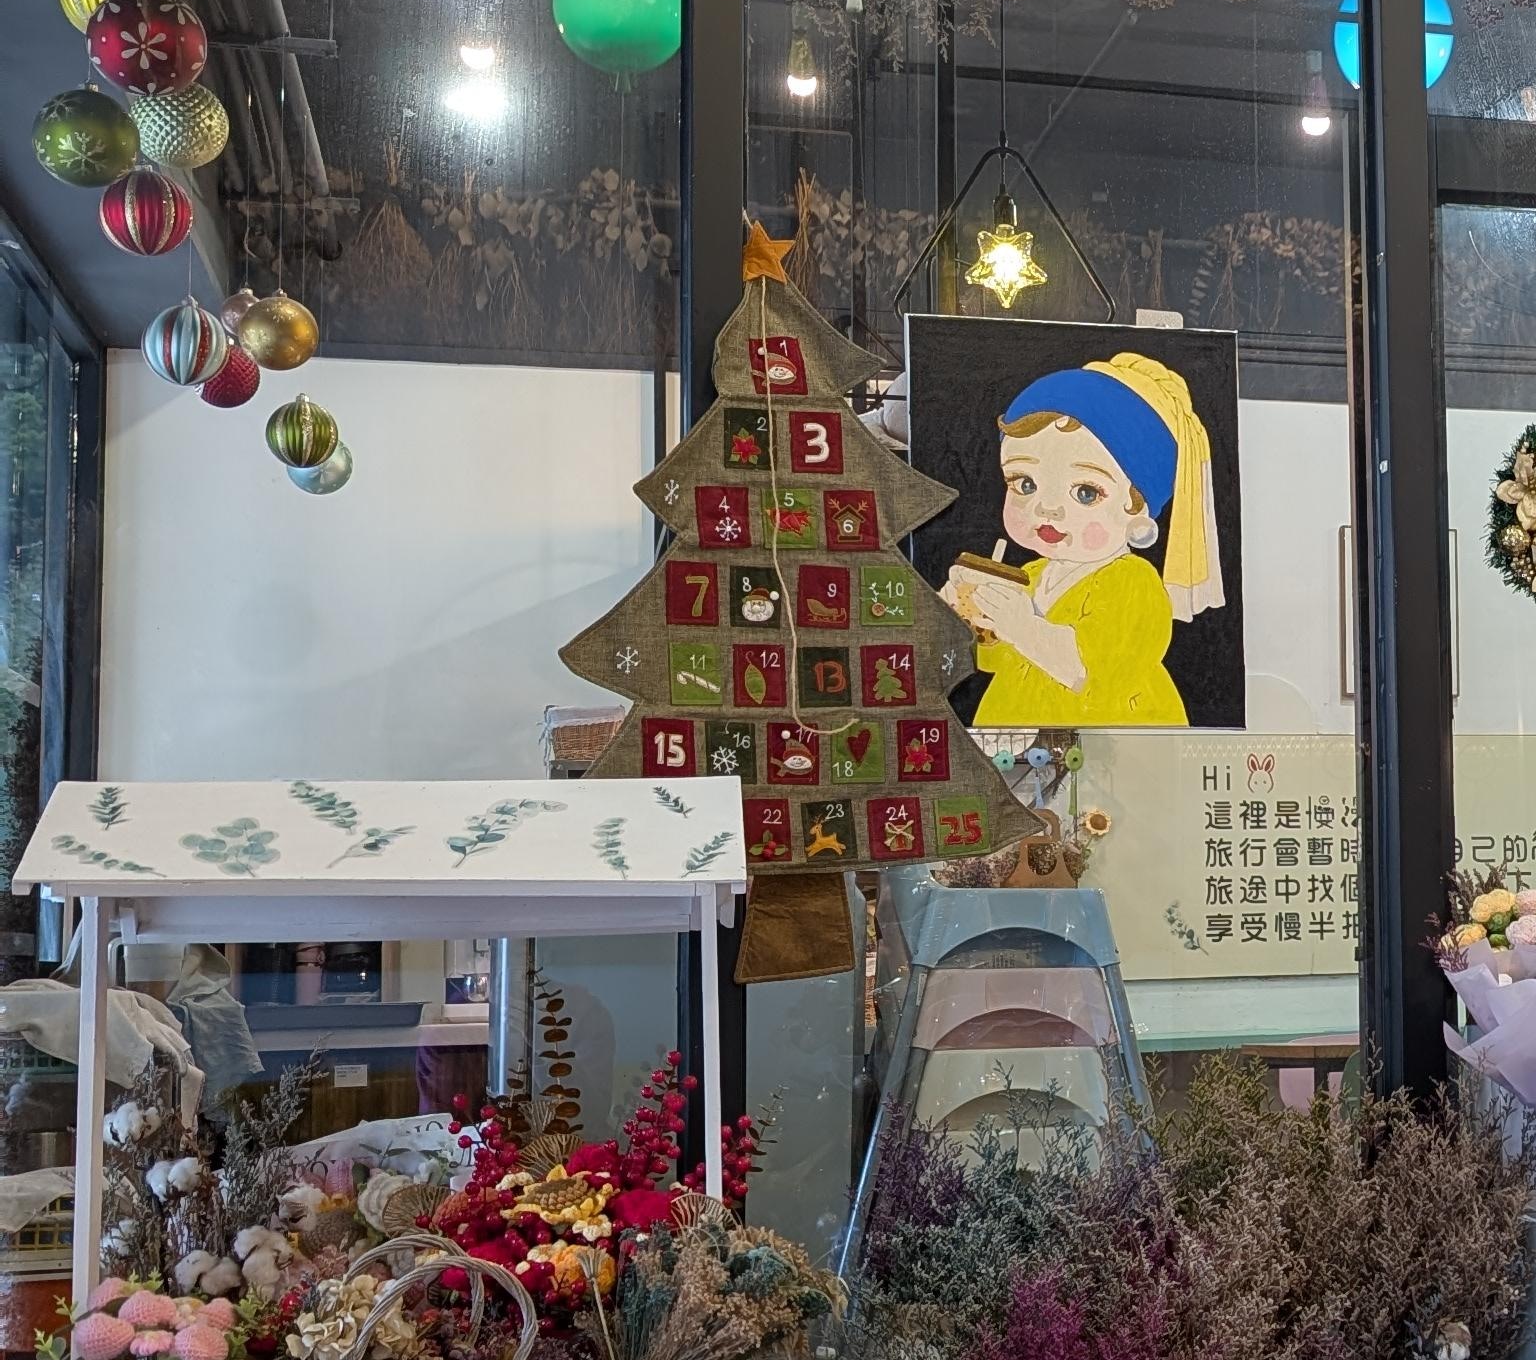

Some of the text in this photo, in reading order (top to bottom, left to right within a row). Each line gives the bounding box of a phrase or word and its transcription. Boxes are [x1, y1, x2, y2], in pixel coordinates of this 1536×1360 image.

[756, 417, 768, 432] 2
[803, 422, 830, 464] 3
[719, 496, 731, 513] 4
[783, 492, 794, 507] 5
[843, 519, 854, 533] 6
[742, 578, 752, 592] 8
[827, 583, 837, 597] 9
[886, 580, 905, 598] 10
[685, 575, 710, 617] 7
[690, 654, 706, 670] 11
[760, 652, 781, 668] 12
[889, 653, 910, 670] 14
[732, 732, 751, 749] 16
[919, 727, 940, 745] 19
[654, 731, 686, 767] 15
[832, 760, 854, 778] 18
[1202, 765, 1231, 791] Hi
[762, 809, 782, 824] 22
[825, 804, 845, 820] 23
[886, 805, 908, 821] 24
[940, 813, 983, 845] 25
